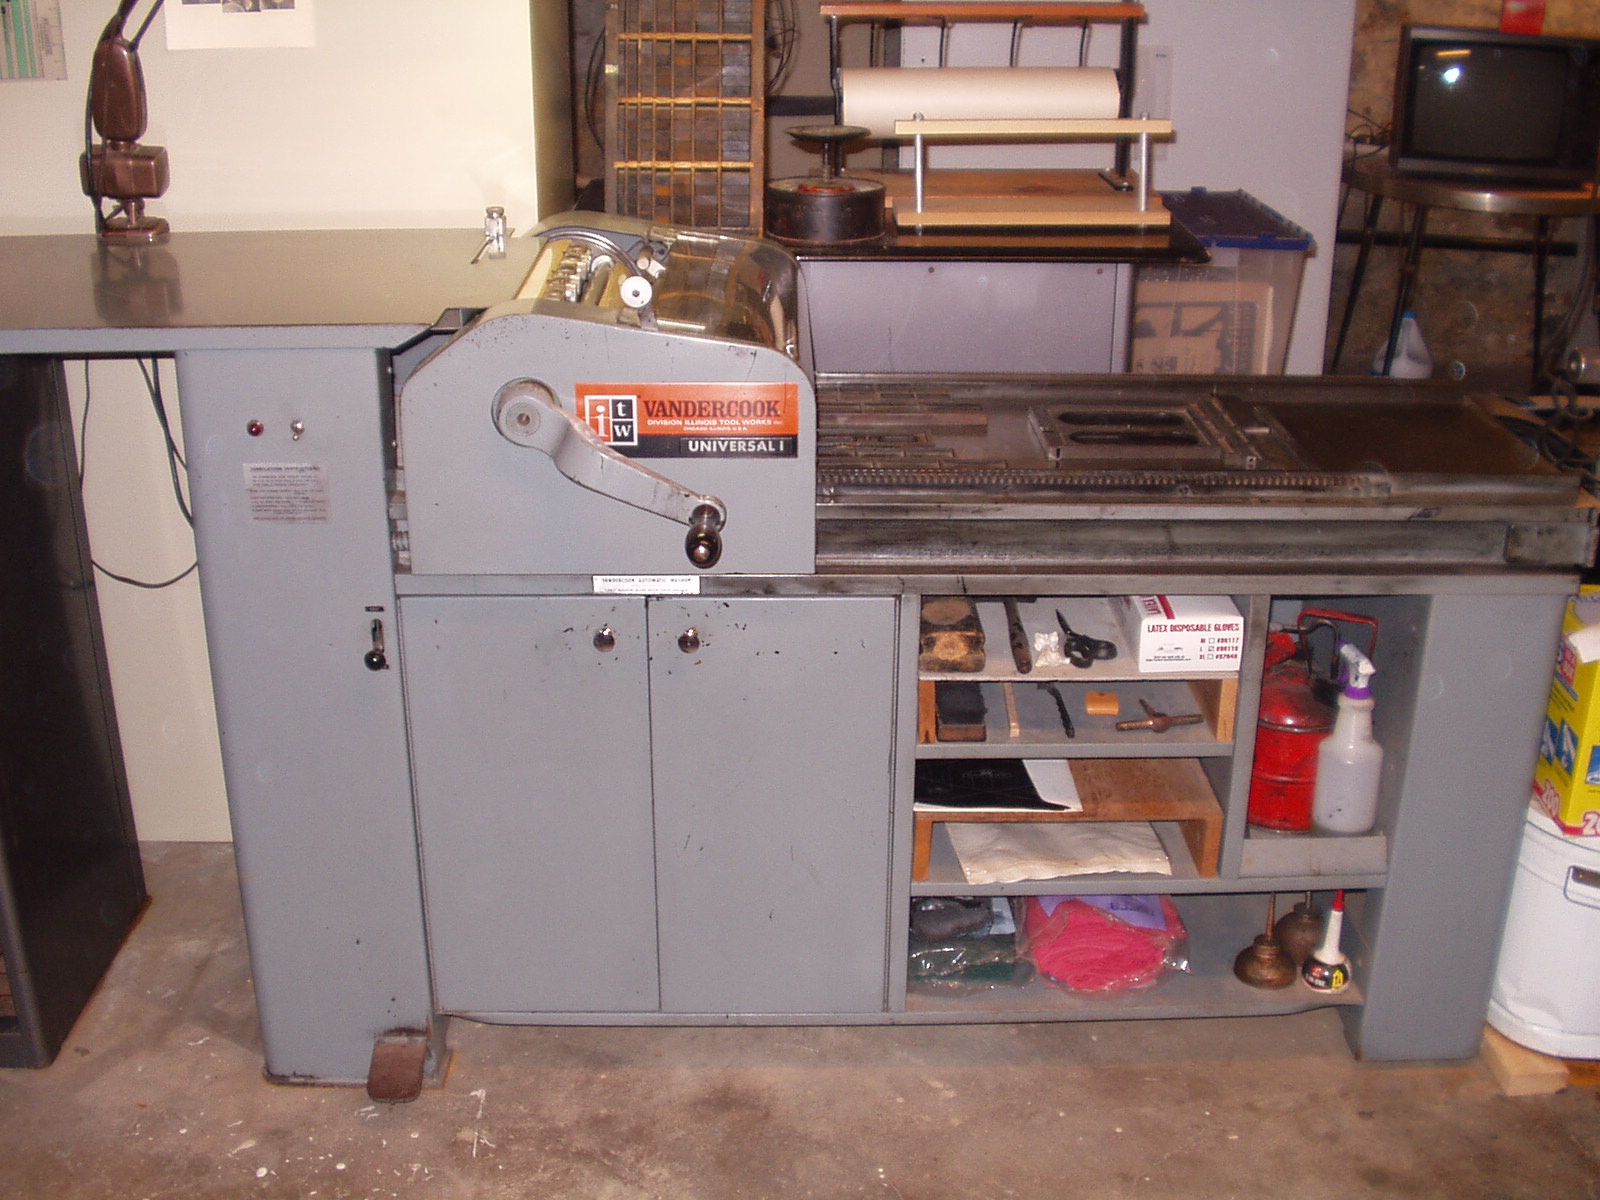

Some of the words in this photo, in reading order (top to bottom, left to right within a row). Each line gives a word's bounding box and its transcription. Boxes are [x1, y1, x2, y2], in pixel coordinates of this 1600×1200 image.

[643, 400, 780, 417] VANDERCOOK
[688, 440, 776, 452] UNIVERSAL
[1148, 624, 1168, 633] LATEX
[1170, 623, 1212, 632] DISPOSABLE
[1214, 623, 1240, 632] GLOVES
